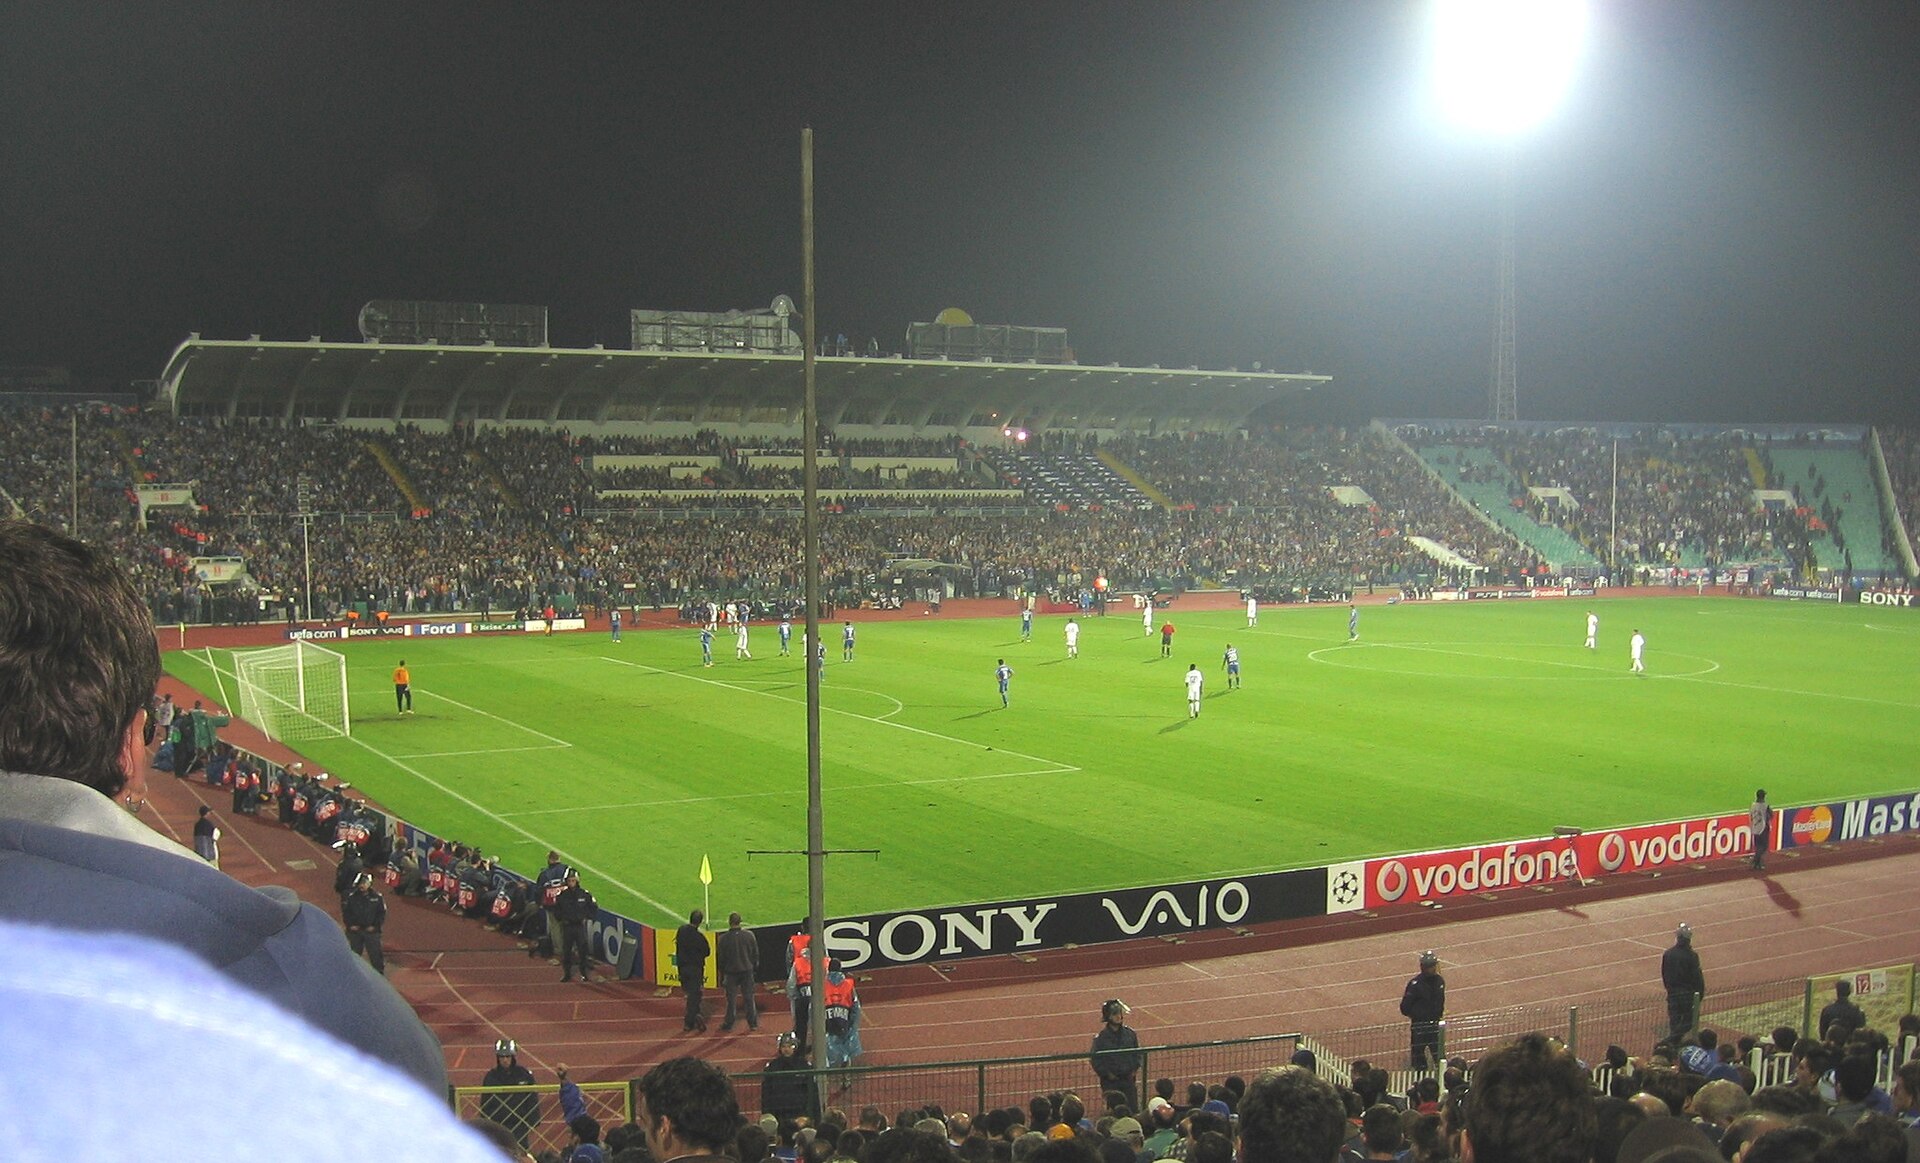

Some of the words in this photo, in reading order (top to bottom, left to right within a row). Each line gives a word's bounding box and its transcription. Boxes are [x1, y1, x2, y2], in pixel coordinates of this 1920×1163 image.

[1860, 591, 1914, 606] SONY
[350, 627, 378, 636] SONY
[421, 623, 456, 635] Ford
[1632, 821, 1751, 866] vodafon
[1412, 846, 1577, 898] vodafone
[826, 903, 1057, 968] SONY
[1103, 882, 1250, 935] VAIO
[1857, 979, 1870, 994] 12
